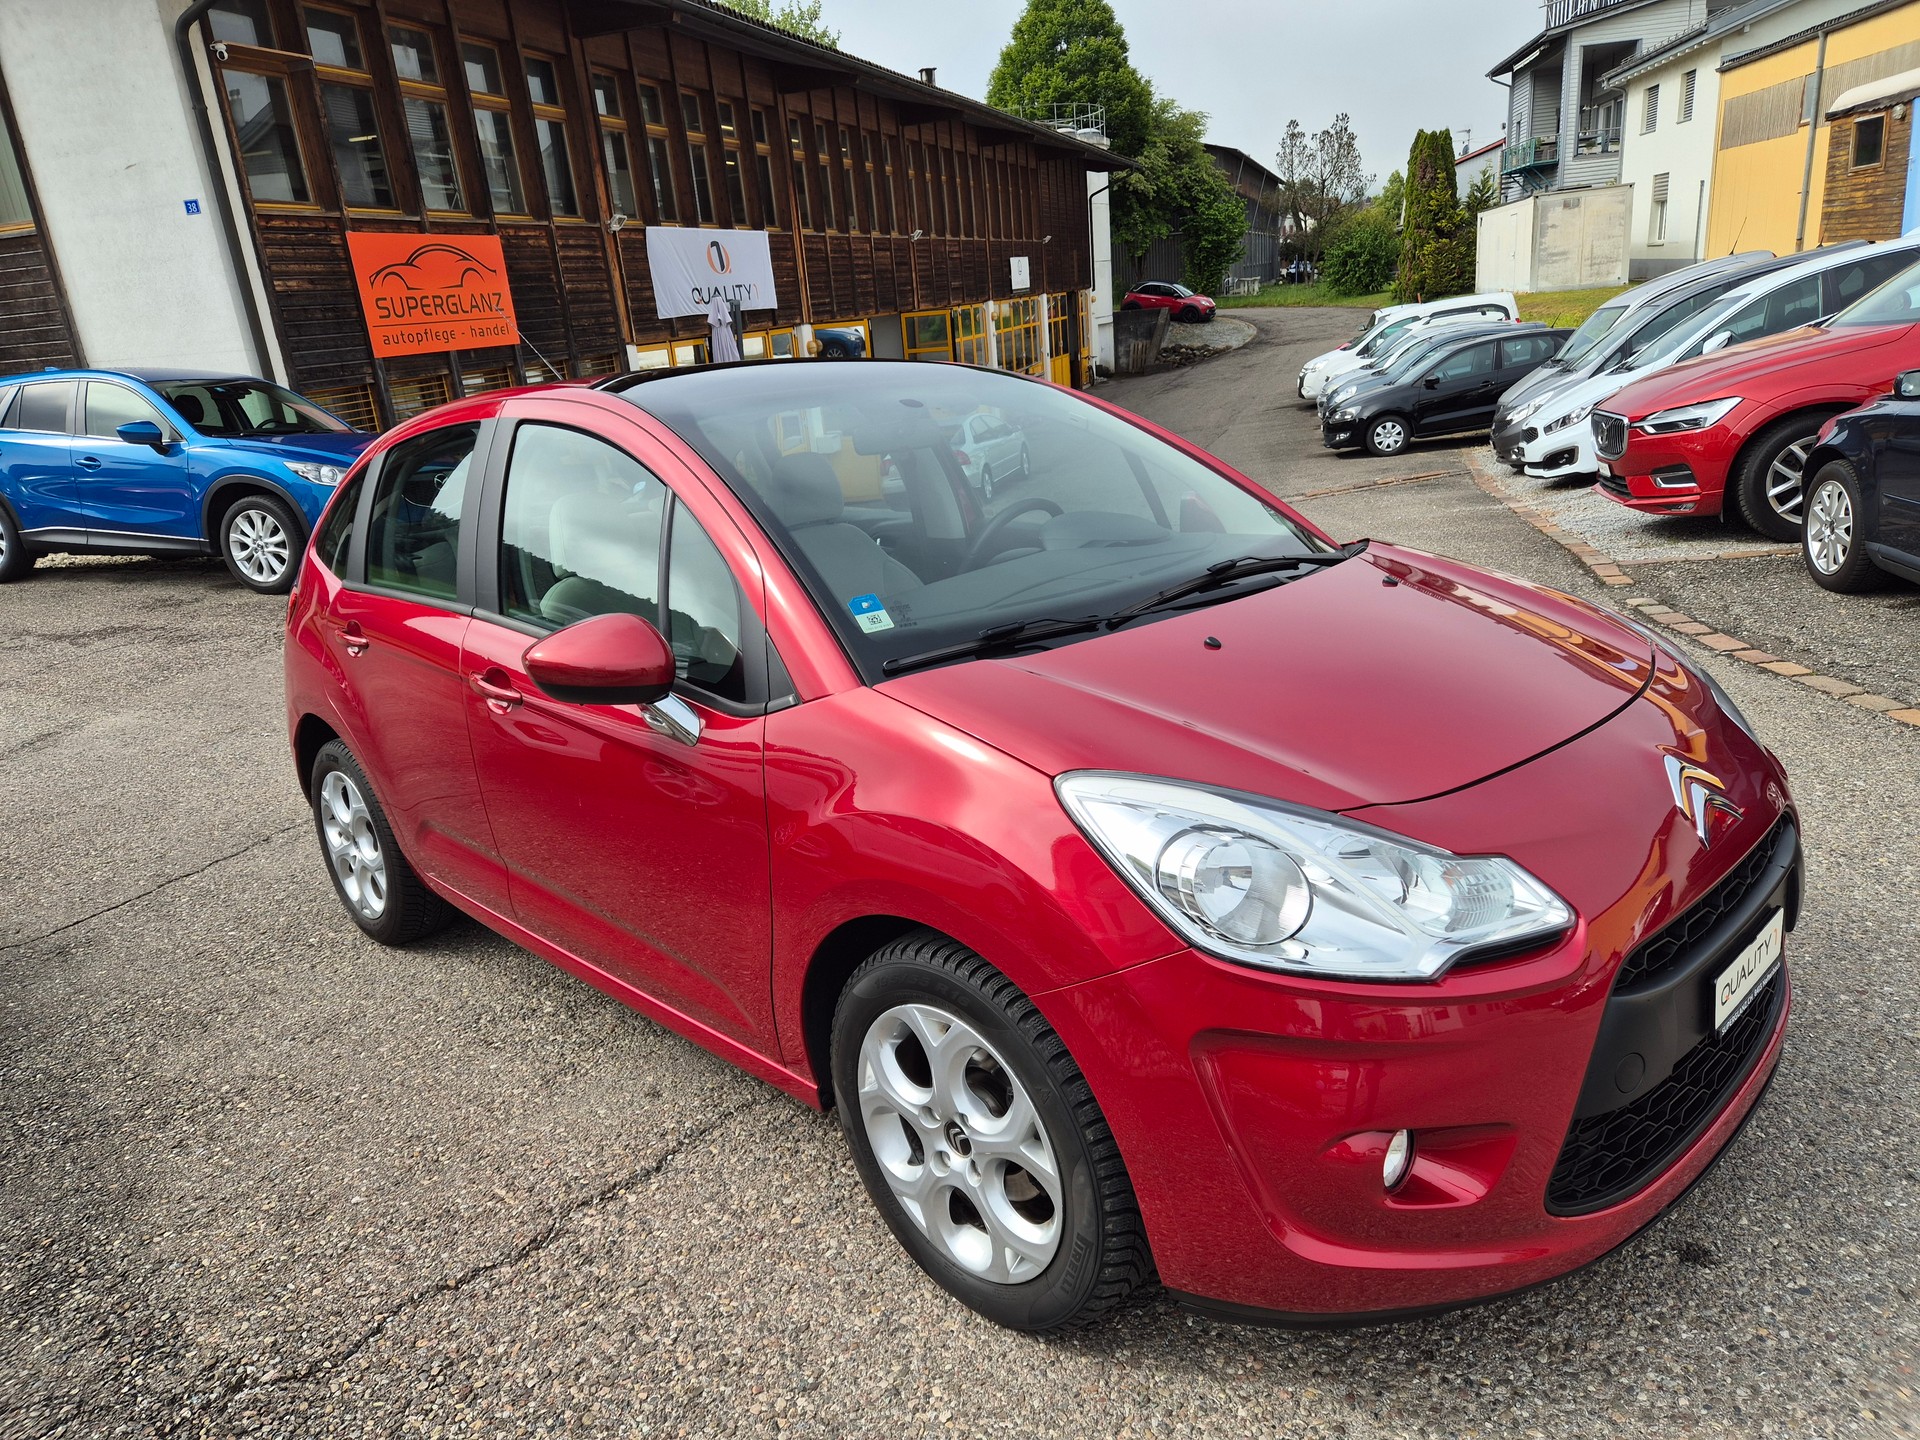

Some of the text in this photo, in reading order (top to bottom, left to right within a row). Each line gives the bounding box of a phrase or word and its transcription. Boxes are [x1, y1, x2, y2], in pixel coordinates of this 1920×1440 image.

[187, 202, 198, 213] 38
[375, 292, 505, 319] SUPERGLANZ
[383, 328, 456, 346] autopflege
[470, 323, 510, 338] handel
